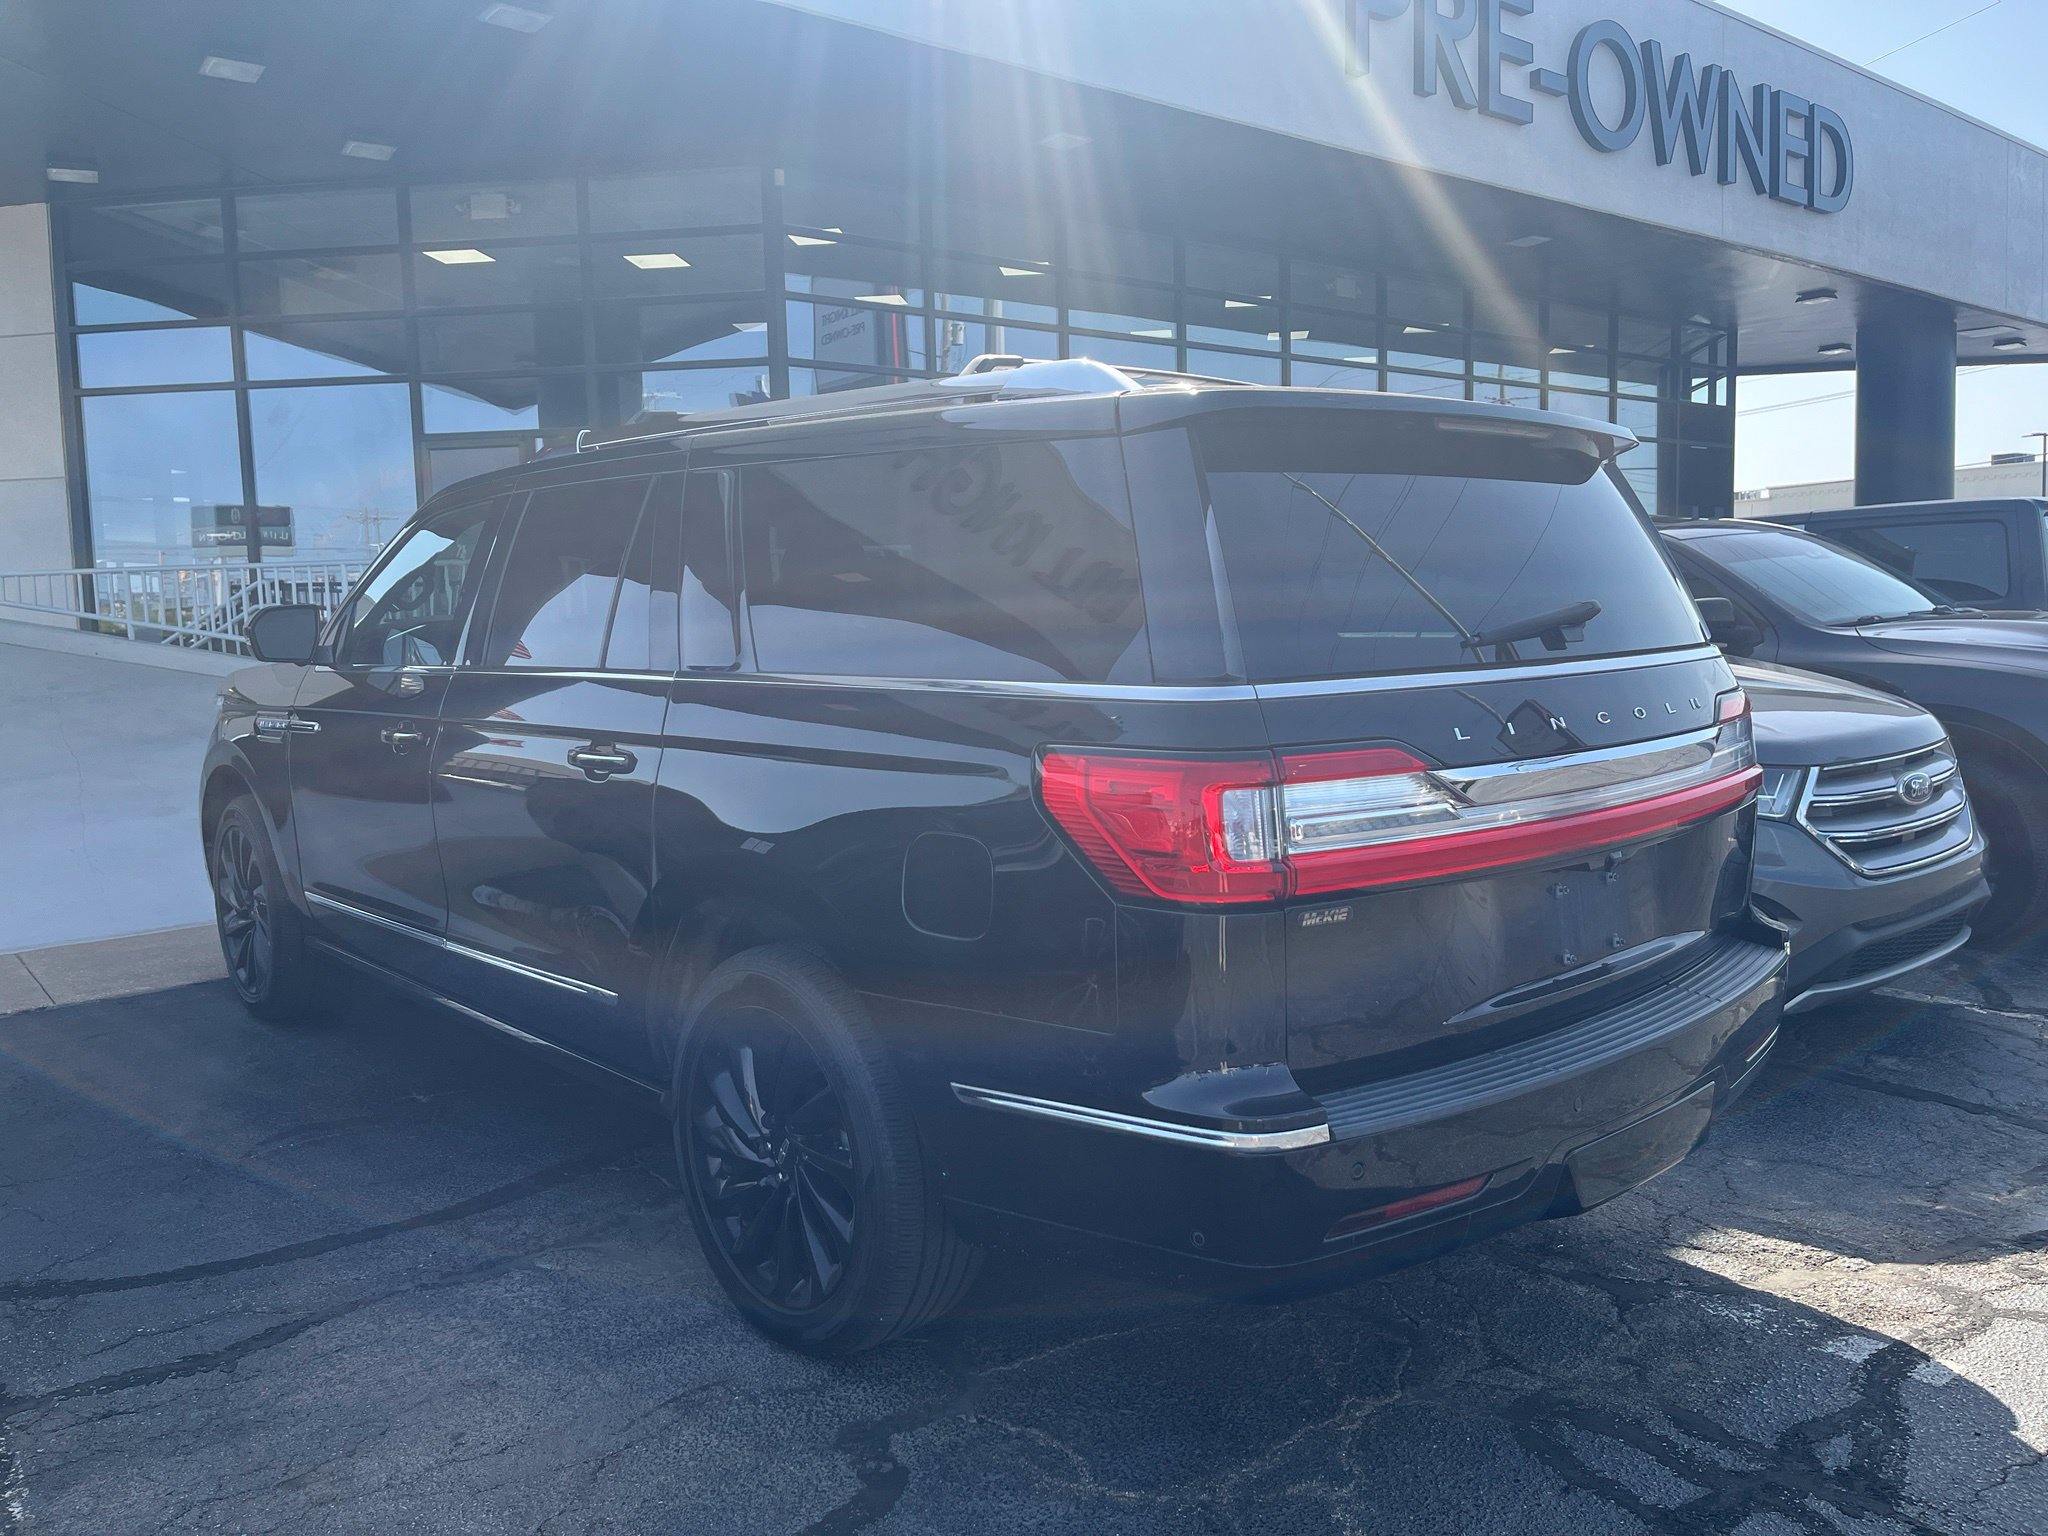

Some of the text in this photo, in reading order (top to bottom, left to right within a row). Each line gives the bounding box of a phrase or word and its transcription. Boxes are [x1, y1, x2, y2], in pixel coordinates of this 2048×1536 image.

[1345, 0, 1854, 213] PRE-OWNED
[1453, 697, 1702, 741] LINCOLN
[1909, 777, 1930, 798] Ford
